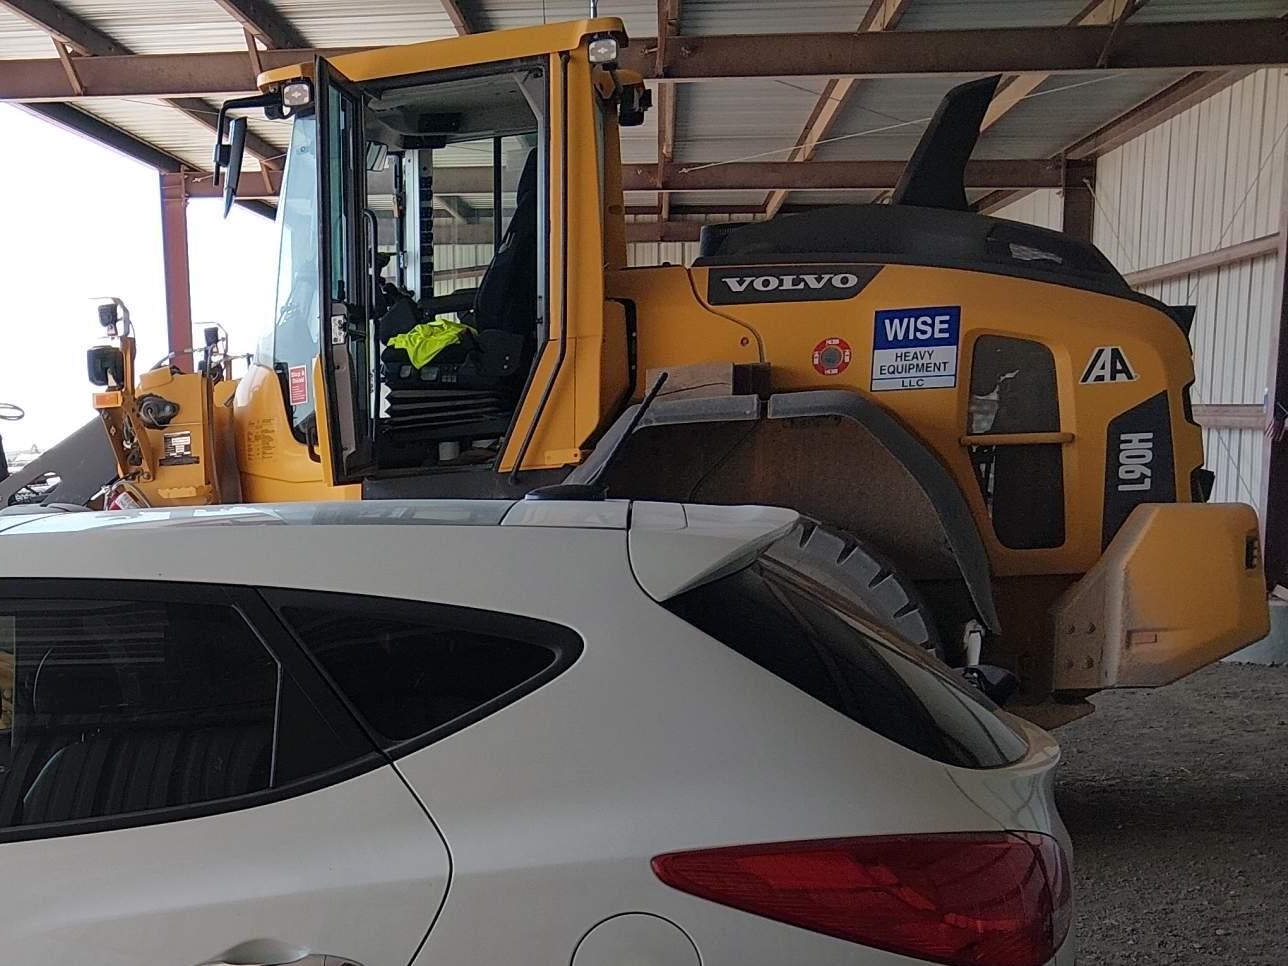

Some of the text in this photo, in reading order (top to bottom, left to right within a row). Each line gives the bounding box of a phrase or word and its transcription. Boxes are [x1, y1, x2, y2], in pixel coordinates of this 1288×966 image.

[721, 273, 859, 292] VOLVO
[884, 315, 950, 342] WISE
[895, 350, 934, 362] HEAVY
[879, 361, 949, 375] EQUIPMENT
[901, 378, 925, 388] LLC
[1117, 432, 1154, 491] L90H
